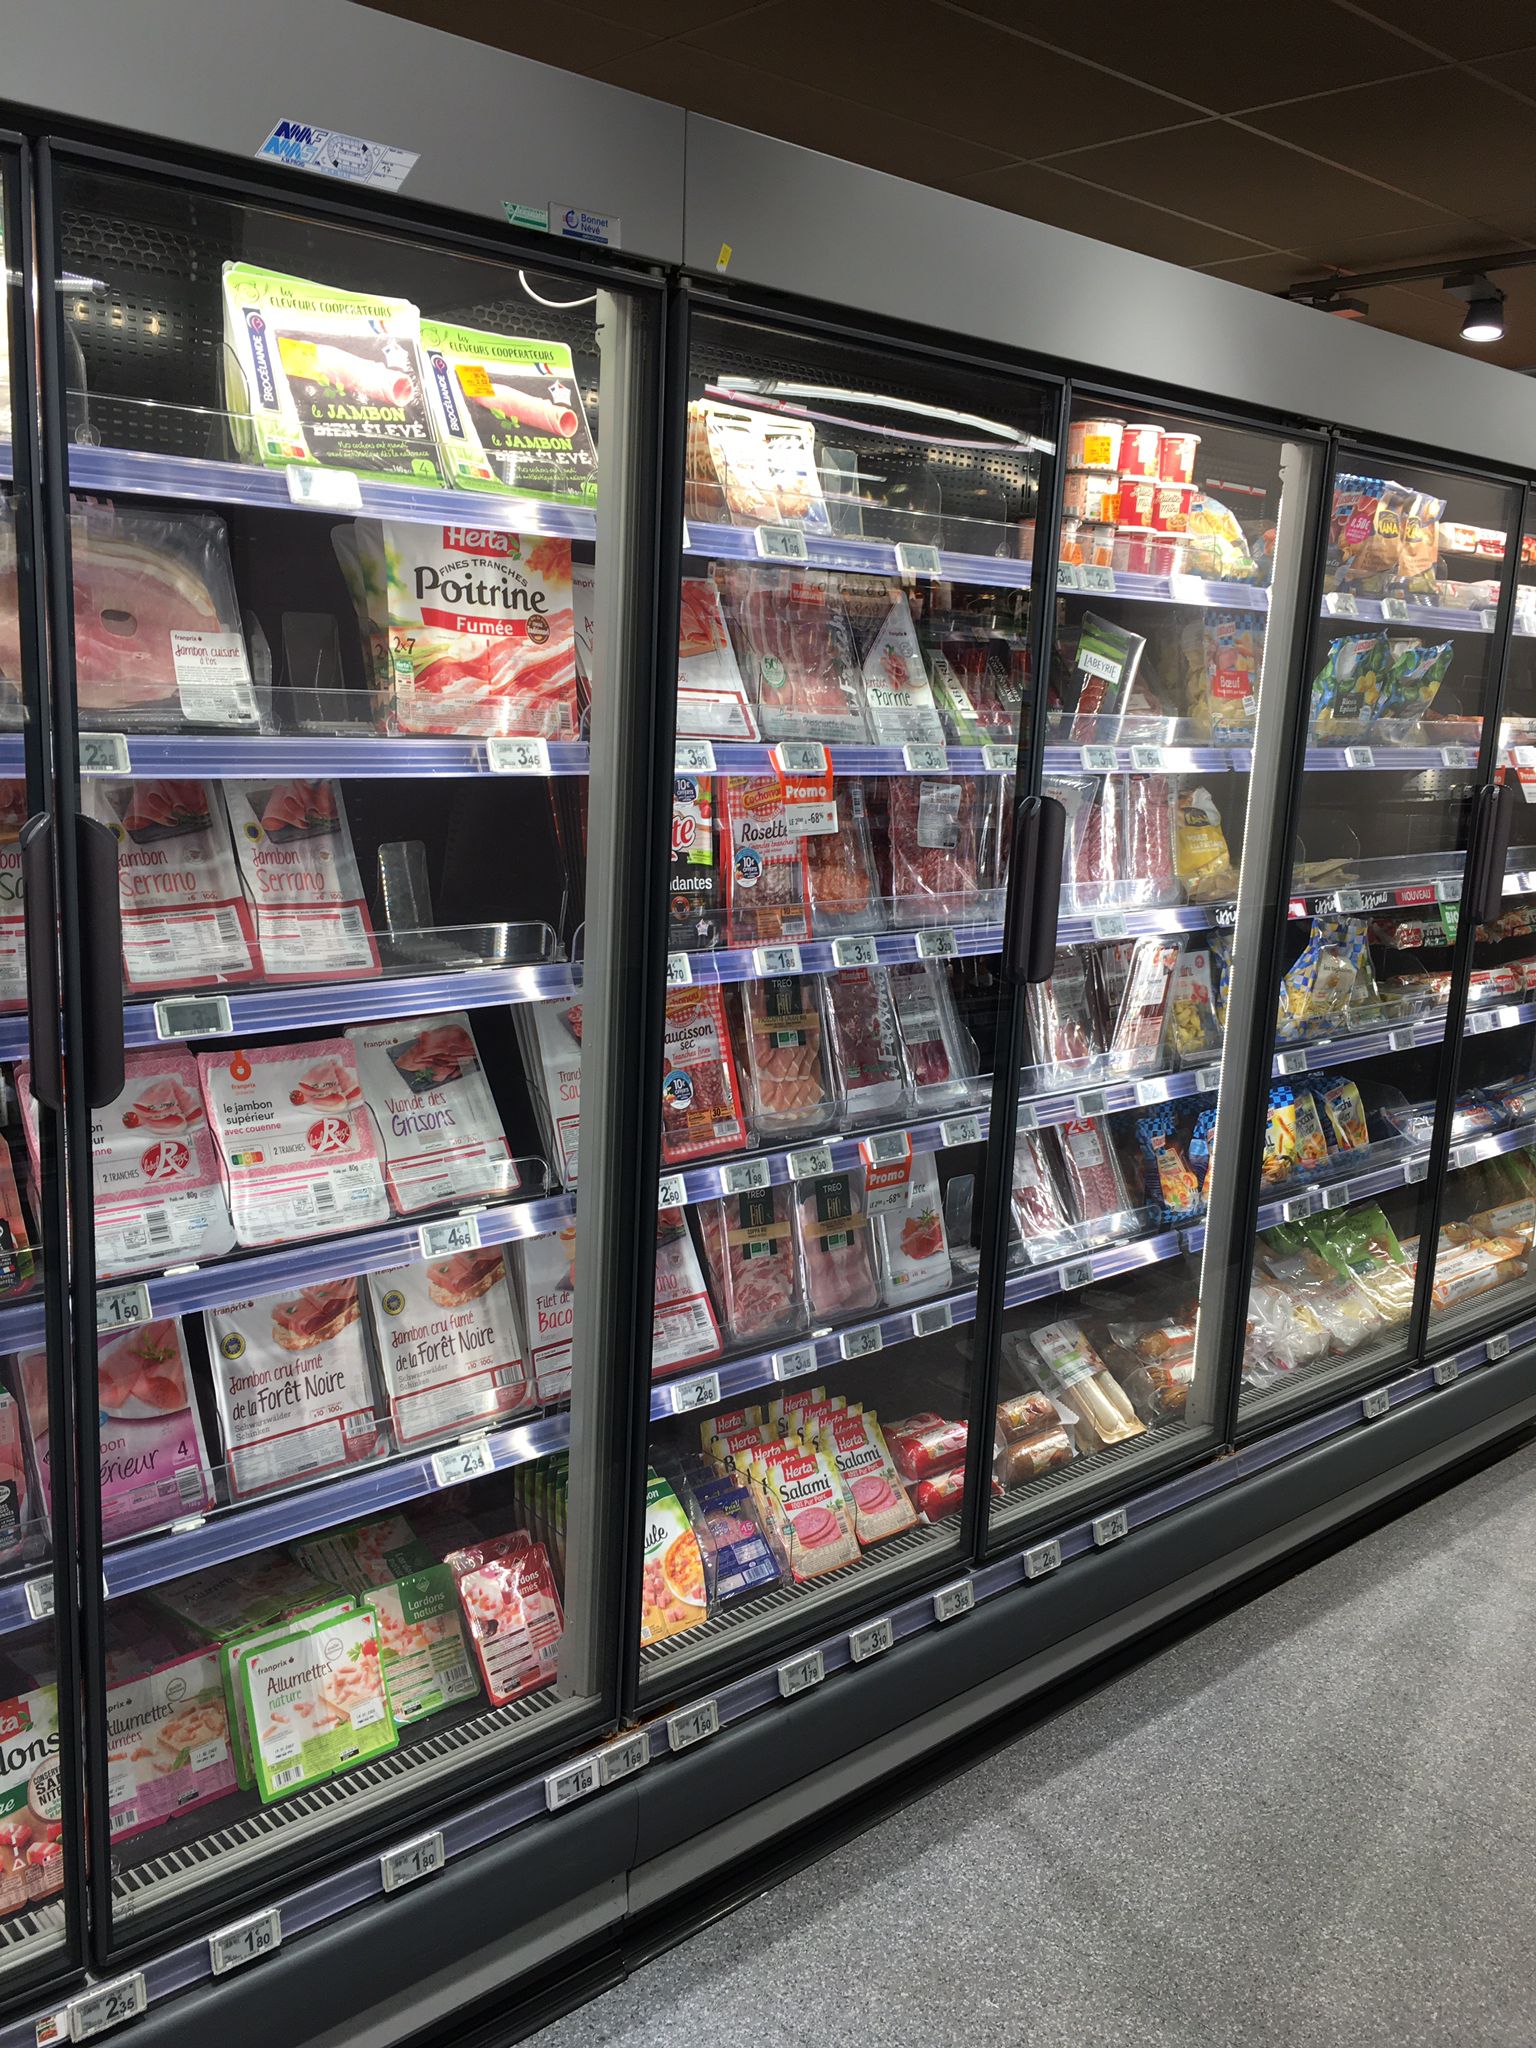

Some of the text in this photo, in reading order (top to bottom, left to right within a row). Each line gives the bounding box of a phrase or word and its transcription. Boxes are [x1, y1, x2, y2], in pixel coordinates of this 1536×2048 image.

[581, 213, 609, 228] Bonnet
[581, 222, 600, 235] Névé
[311, 404, 406, 422] le JAMBON
[492, 434, 573, 451] le JAMBON
[419, 461, 429, 476] 4
[448, 528, 508, 551] Herta
[439, 558, 529, 587] FINES TRANCHES
[414, 566, 549, 614] Poitrine
[456, 616, 514, 635] Fumée
[174, 634, 197, 642] franprix
[393, 636, 416, 656] 2x7
[175, 644, 241, 659] Jambon cuisiné
[1083, 654, 1117, 678] LABEYRIE
[1220, 676, 1241, 688] Bœuf
[872, 688, 913, 707] Parme
[786, 786, 826, 799] Promo
[251, 848, 300, 874] Jambon
[120, 869, 196, 897] Serrano
[256, 870, 324, 895] Serrano
[1401, 890, 1430, 901] NOUVEAU
[363, 1039, 392, 1049] franprix
[680, 1039, 695, 1050] sec
[223, 1101, 273, 1115] le jambon
[384, 1092, 447, 1115] Viande des
[712, 1107, 720, 1117] 30
[226, 1111, 274, 1126] supérieur
[392, 1108, 456, 1137] Grisons
[224, 1122, 281, 1136] avec couenne
[274, 1143, 306, 1155] 2 TRANCHES
[103, 1170, 140, 1183] 2 TRANCHES
[869, 1170, 904, 1185] Promo
[536, 1291, 571, 1309] Filet de
[213, 1303, 247, 1315] franprix
[391, 1312, 474, 1348] Jambon cru fumé
[396, 1326, 495, 1371] de la Forêt Noire
[229, 1354, 324, 1395] Jambon cru fumé
[233, 1371, 346, 1420] de la Forêt Noire
[784, 1396, 808, 1413] Herta
[234, 1410, 292, 1434] Schwarzwälder
[805, 1407, 827, 1420] Herta
[717, 1416, 741, 1430] Herta
[235, 1426, 270, 1442] Schinken
[731, 1434, 756, 1450] Herta
[838, 1433, 863, 1448] Herta
[177, 1440, 188, 1456] 4
[755, 1445, 781, 1460] Herta
[836, 1446, 881, 1470] Salami
[785, 1462, 812, 1479] Herta
[780, 1474, 830, 1503] Salami
[408, 1592, 445, 1610] Lardons
[414, 1603, 444, 1620] nature
[258, 1660, 287, 1675] franprix
[267, 1660, 333, 1697] Allumettes
[269, 1690, 302, 1711] nature
